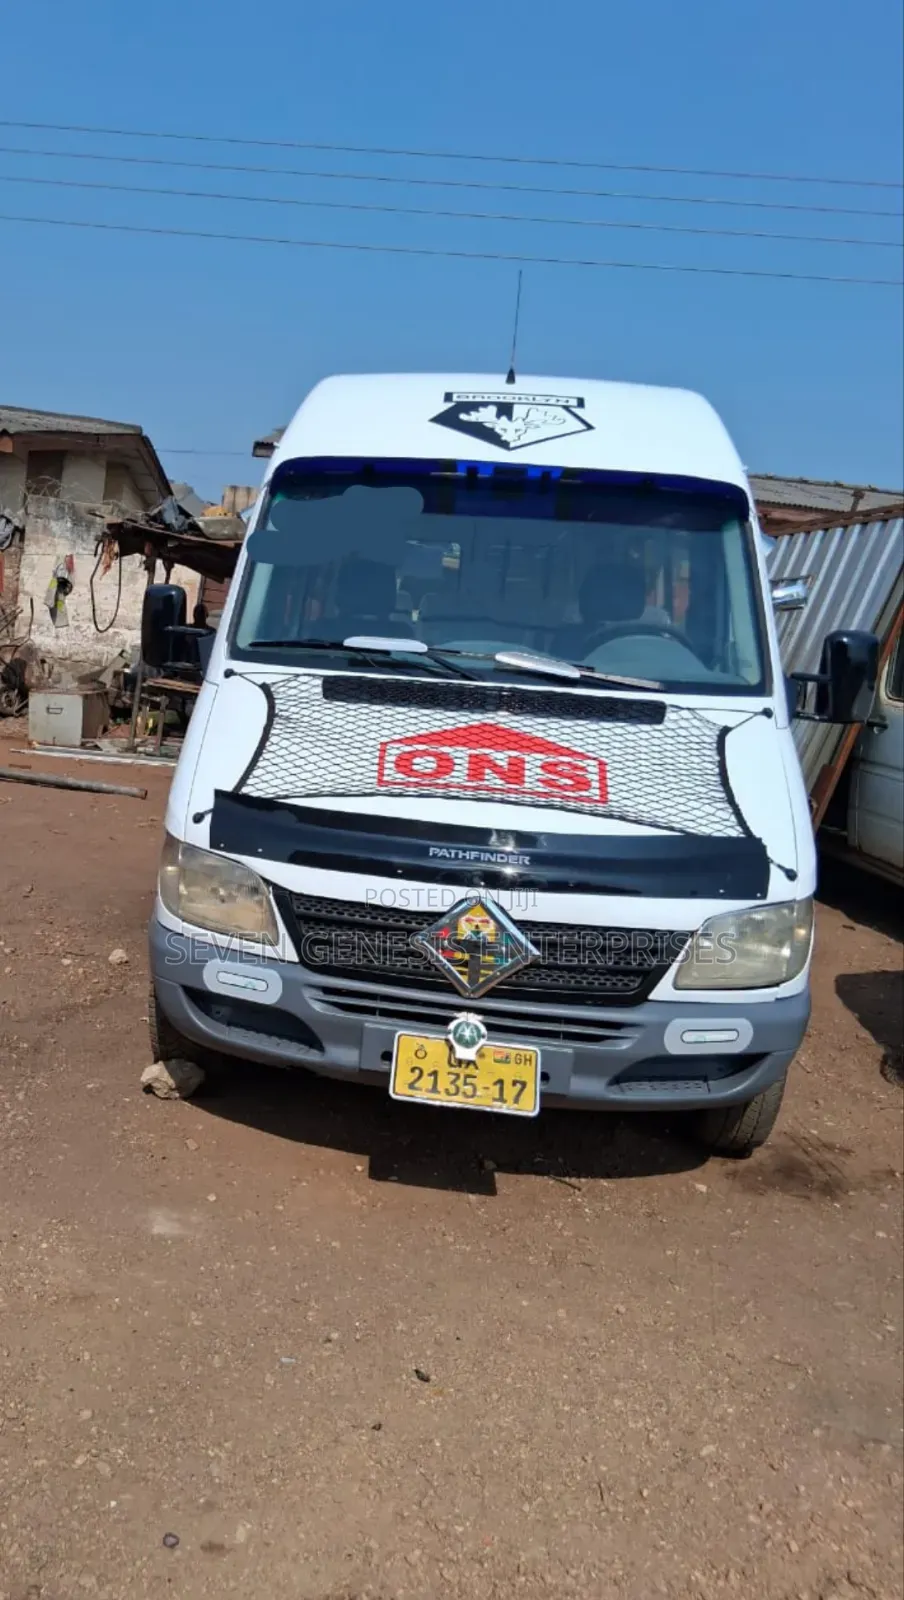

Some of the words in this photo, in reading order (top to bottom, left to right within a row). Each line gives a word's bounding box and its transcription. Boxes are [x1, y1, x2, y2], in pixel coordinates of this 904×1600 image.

[394, 750, 592, 792] ONS
[428, 847, 531, 866] PATHFINDER
[514, 1052, 532, 1066] GH
[407, 1066, 527, 1104] 2135-17
